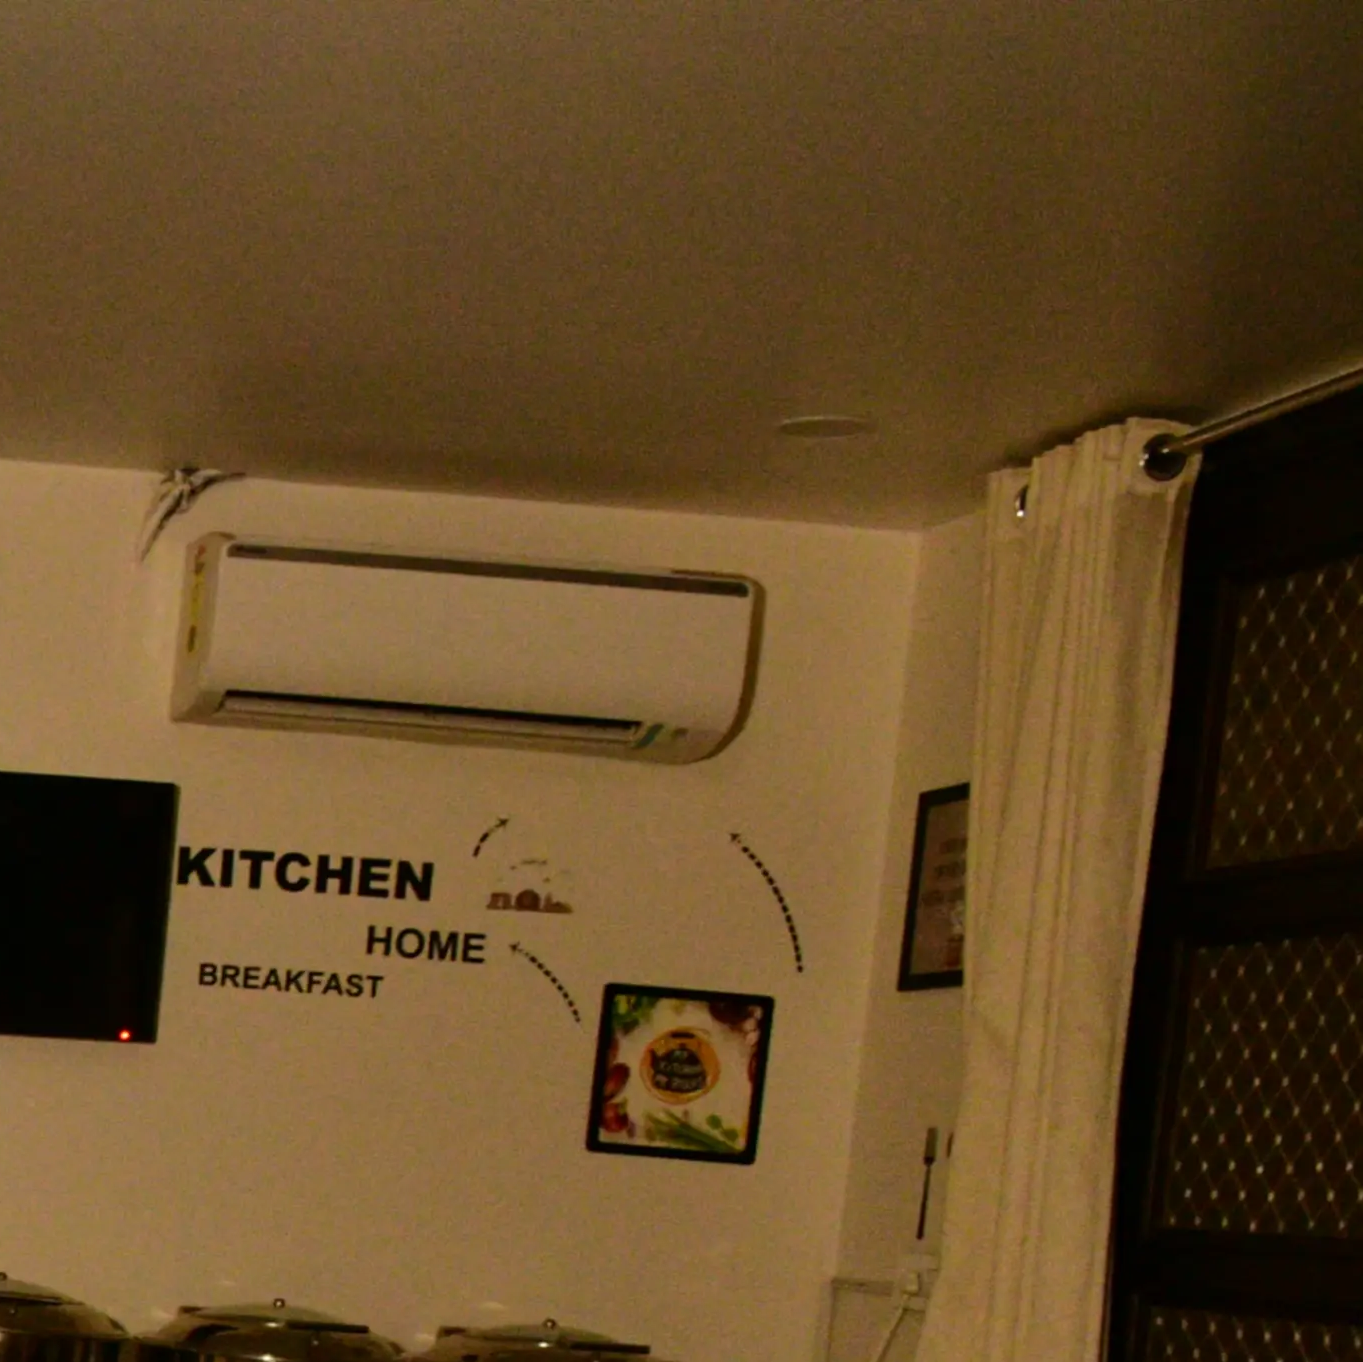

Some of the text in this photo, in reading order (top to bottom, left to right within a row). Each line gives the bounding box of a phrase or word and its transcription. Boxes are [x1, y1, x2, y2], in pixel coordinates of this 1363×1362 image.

[176, 846, 434, 902] KITCHEN
[365, 925, 486, 964] HOME
[197, 963, 385, 998] BREAKFAST
